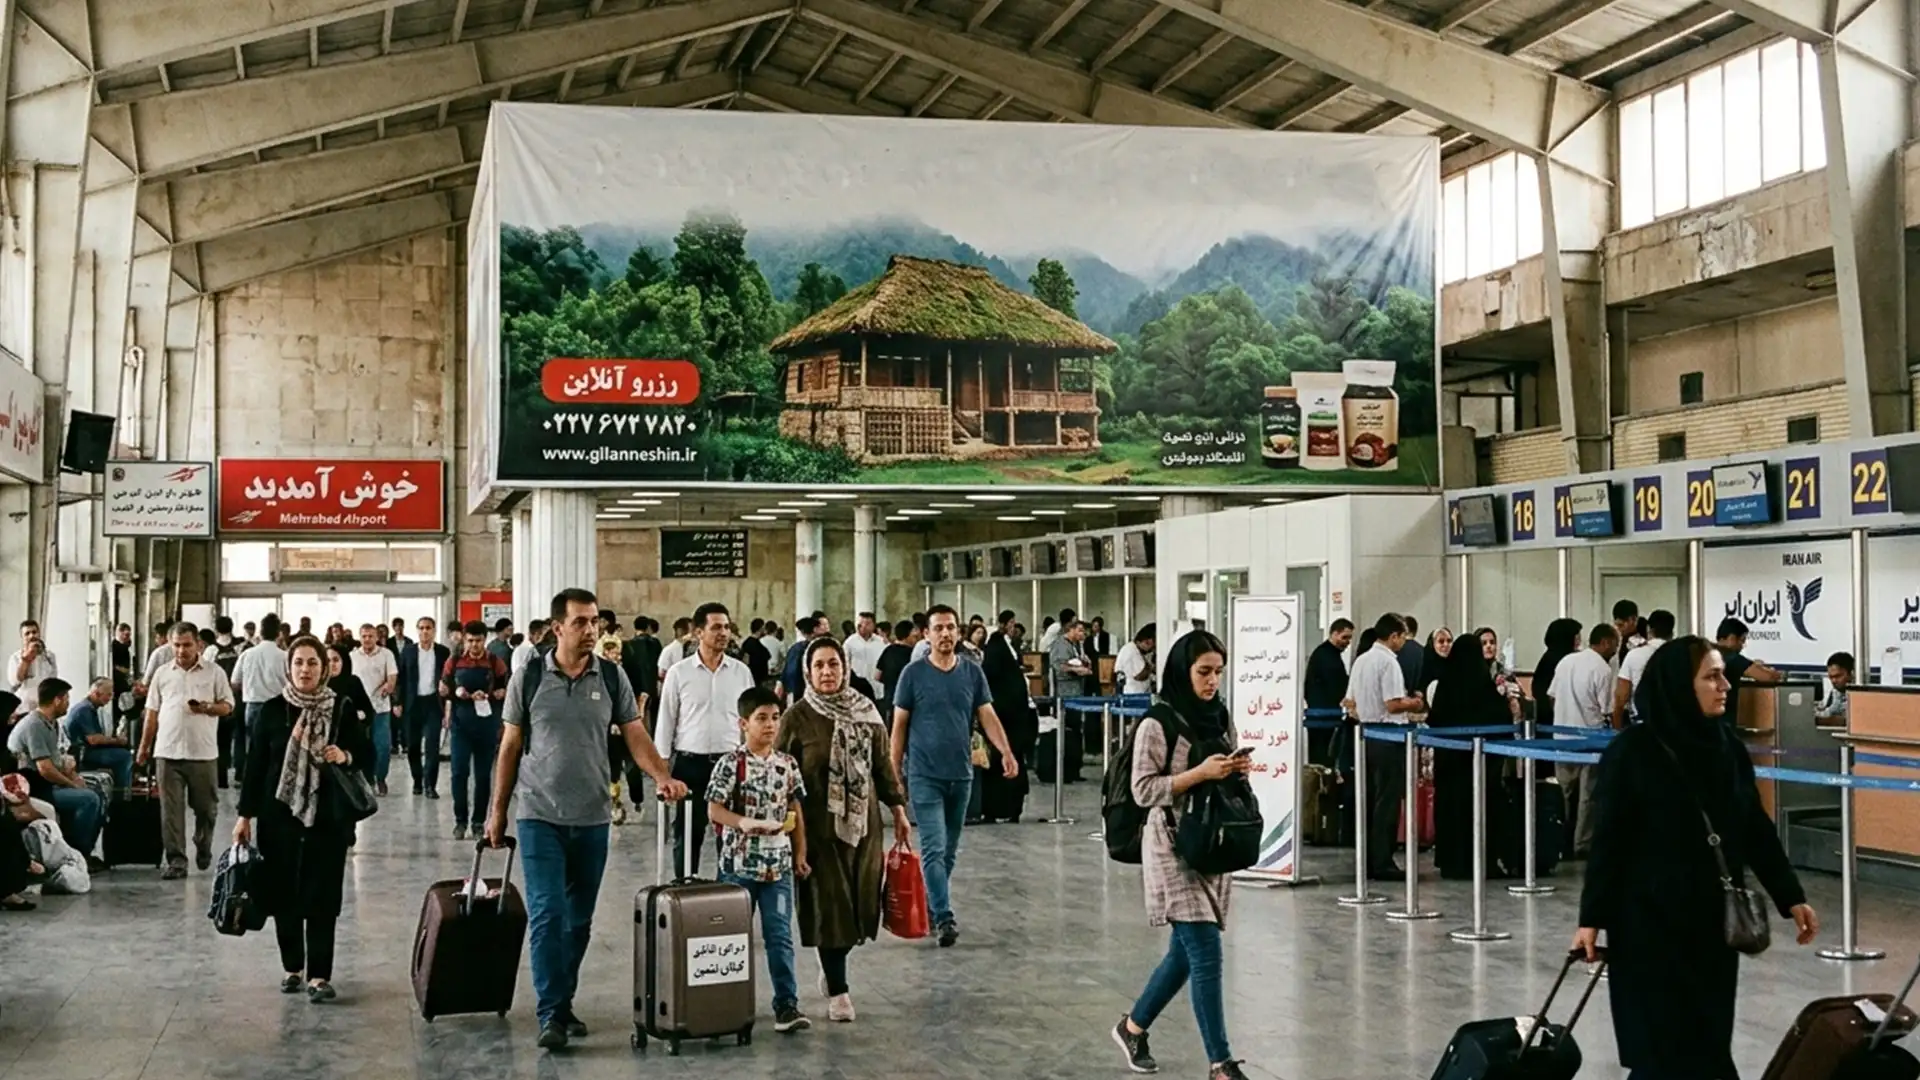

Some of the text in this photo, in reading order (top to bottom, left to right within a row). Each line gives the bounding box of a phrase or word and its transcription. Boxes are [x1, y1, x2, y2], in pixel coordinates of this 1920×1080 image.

[563, 365, 678, 397] رزرو آنلاین
[244, 466, 419, 509] خوش آمدید
[1689, 479, 1714, 517] 20
[1788, 468, 1815, 508] 21
[1853, 460, 1886, 503] 22
[1514, 499, 1533, 532] 18
[1636, 485, 1659, 522] 19
[1451, 507, 1464, 536] 1
[1782, 552, 1822, 566] IRAN AIR
[1743, 589, 1780, 624] ایران
[1898, 595, 1920, 624] یر
